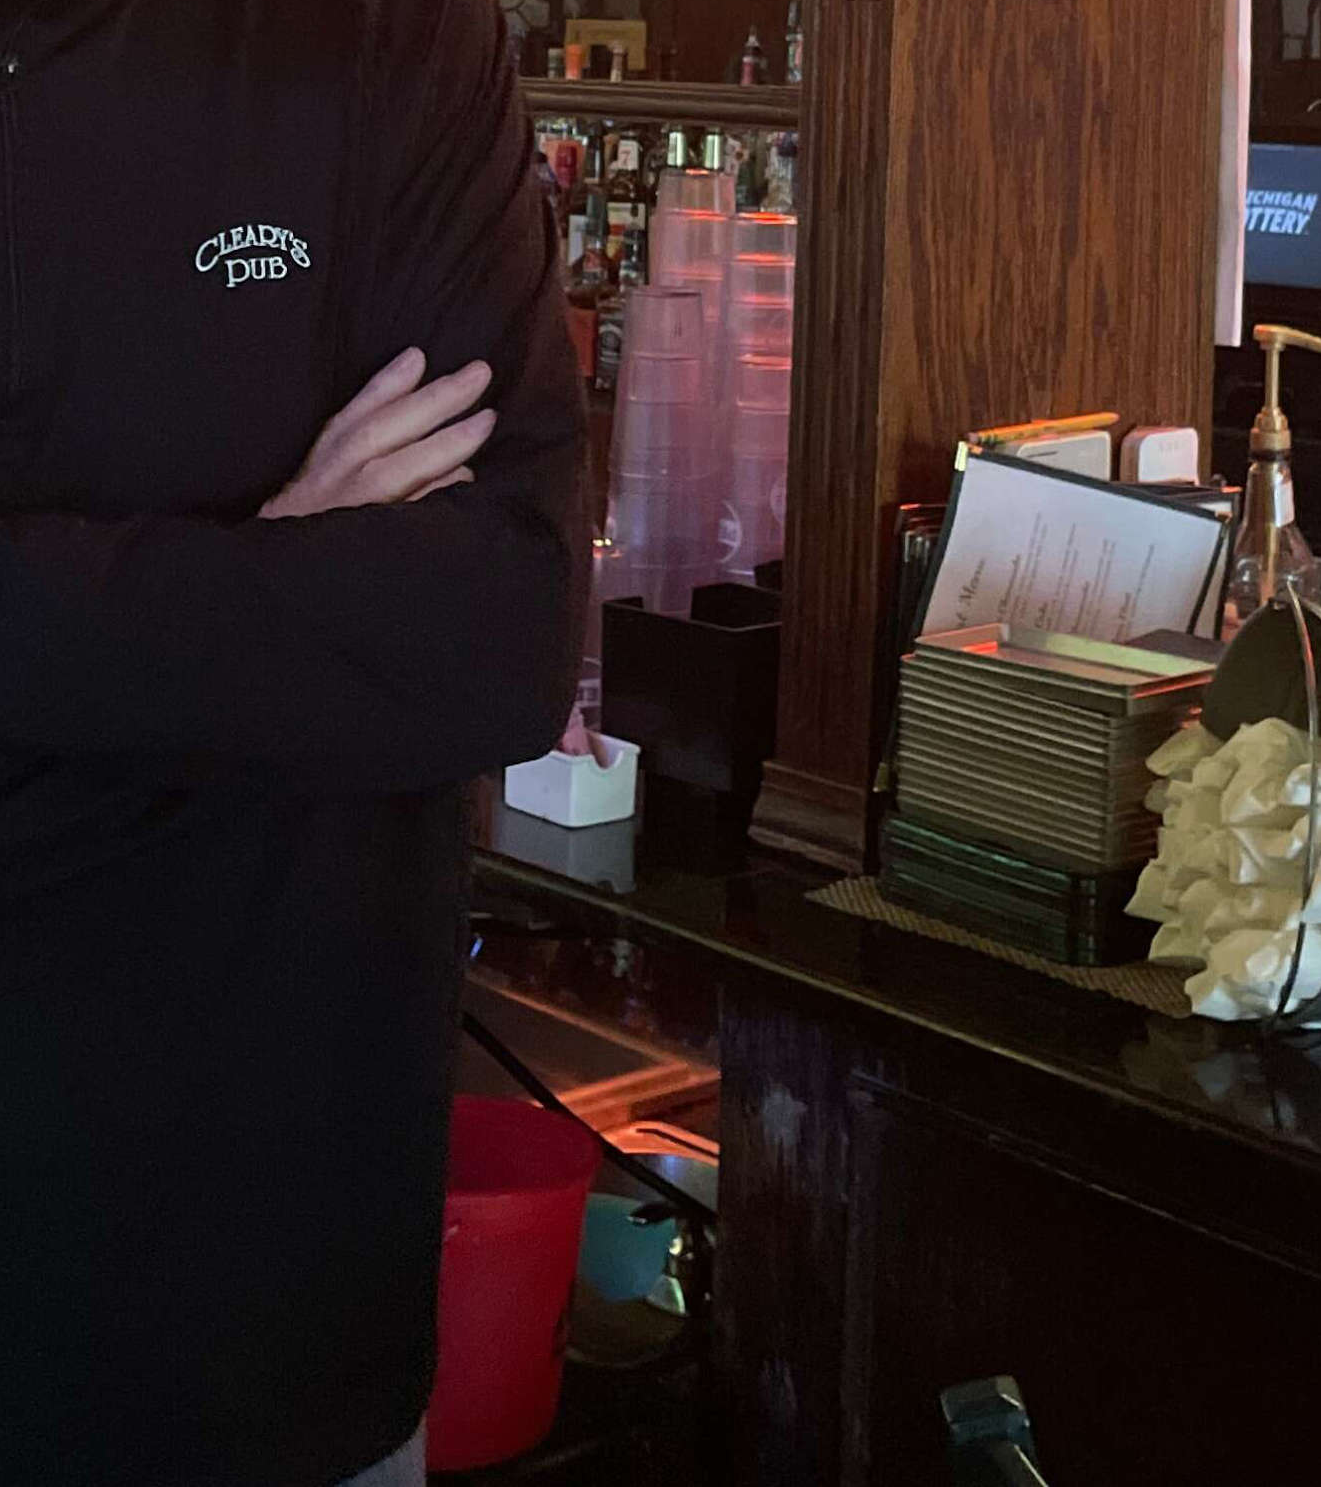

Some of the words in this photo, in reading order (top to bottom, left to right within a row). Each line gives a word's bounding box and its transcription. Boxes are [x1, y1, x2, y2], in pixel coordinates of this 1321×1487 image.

[1246, 190, 1318, 212] ICHIGAN
[1243, 207, 1310, 234] OTTERY
[195, 224, 311, 273] CLEARY'S
[225, 256, 288, 288] PUB
